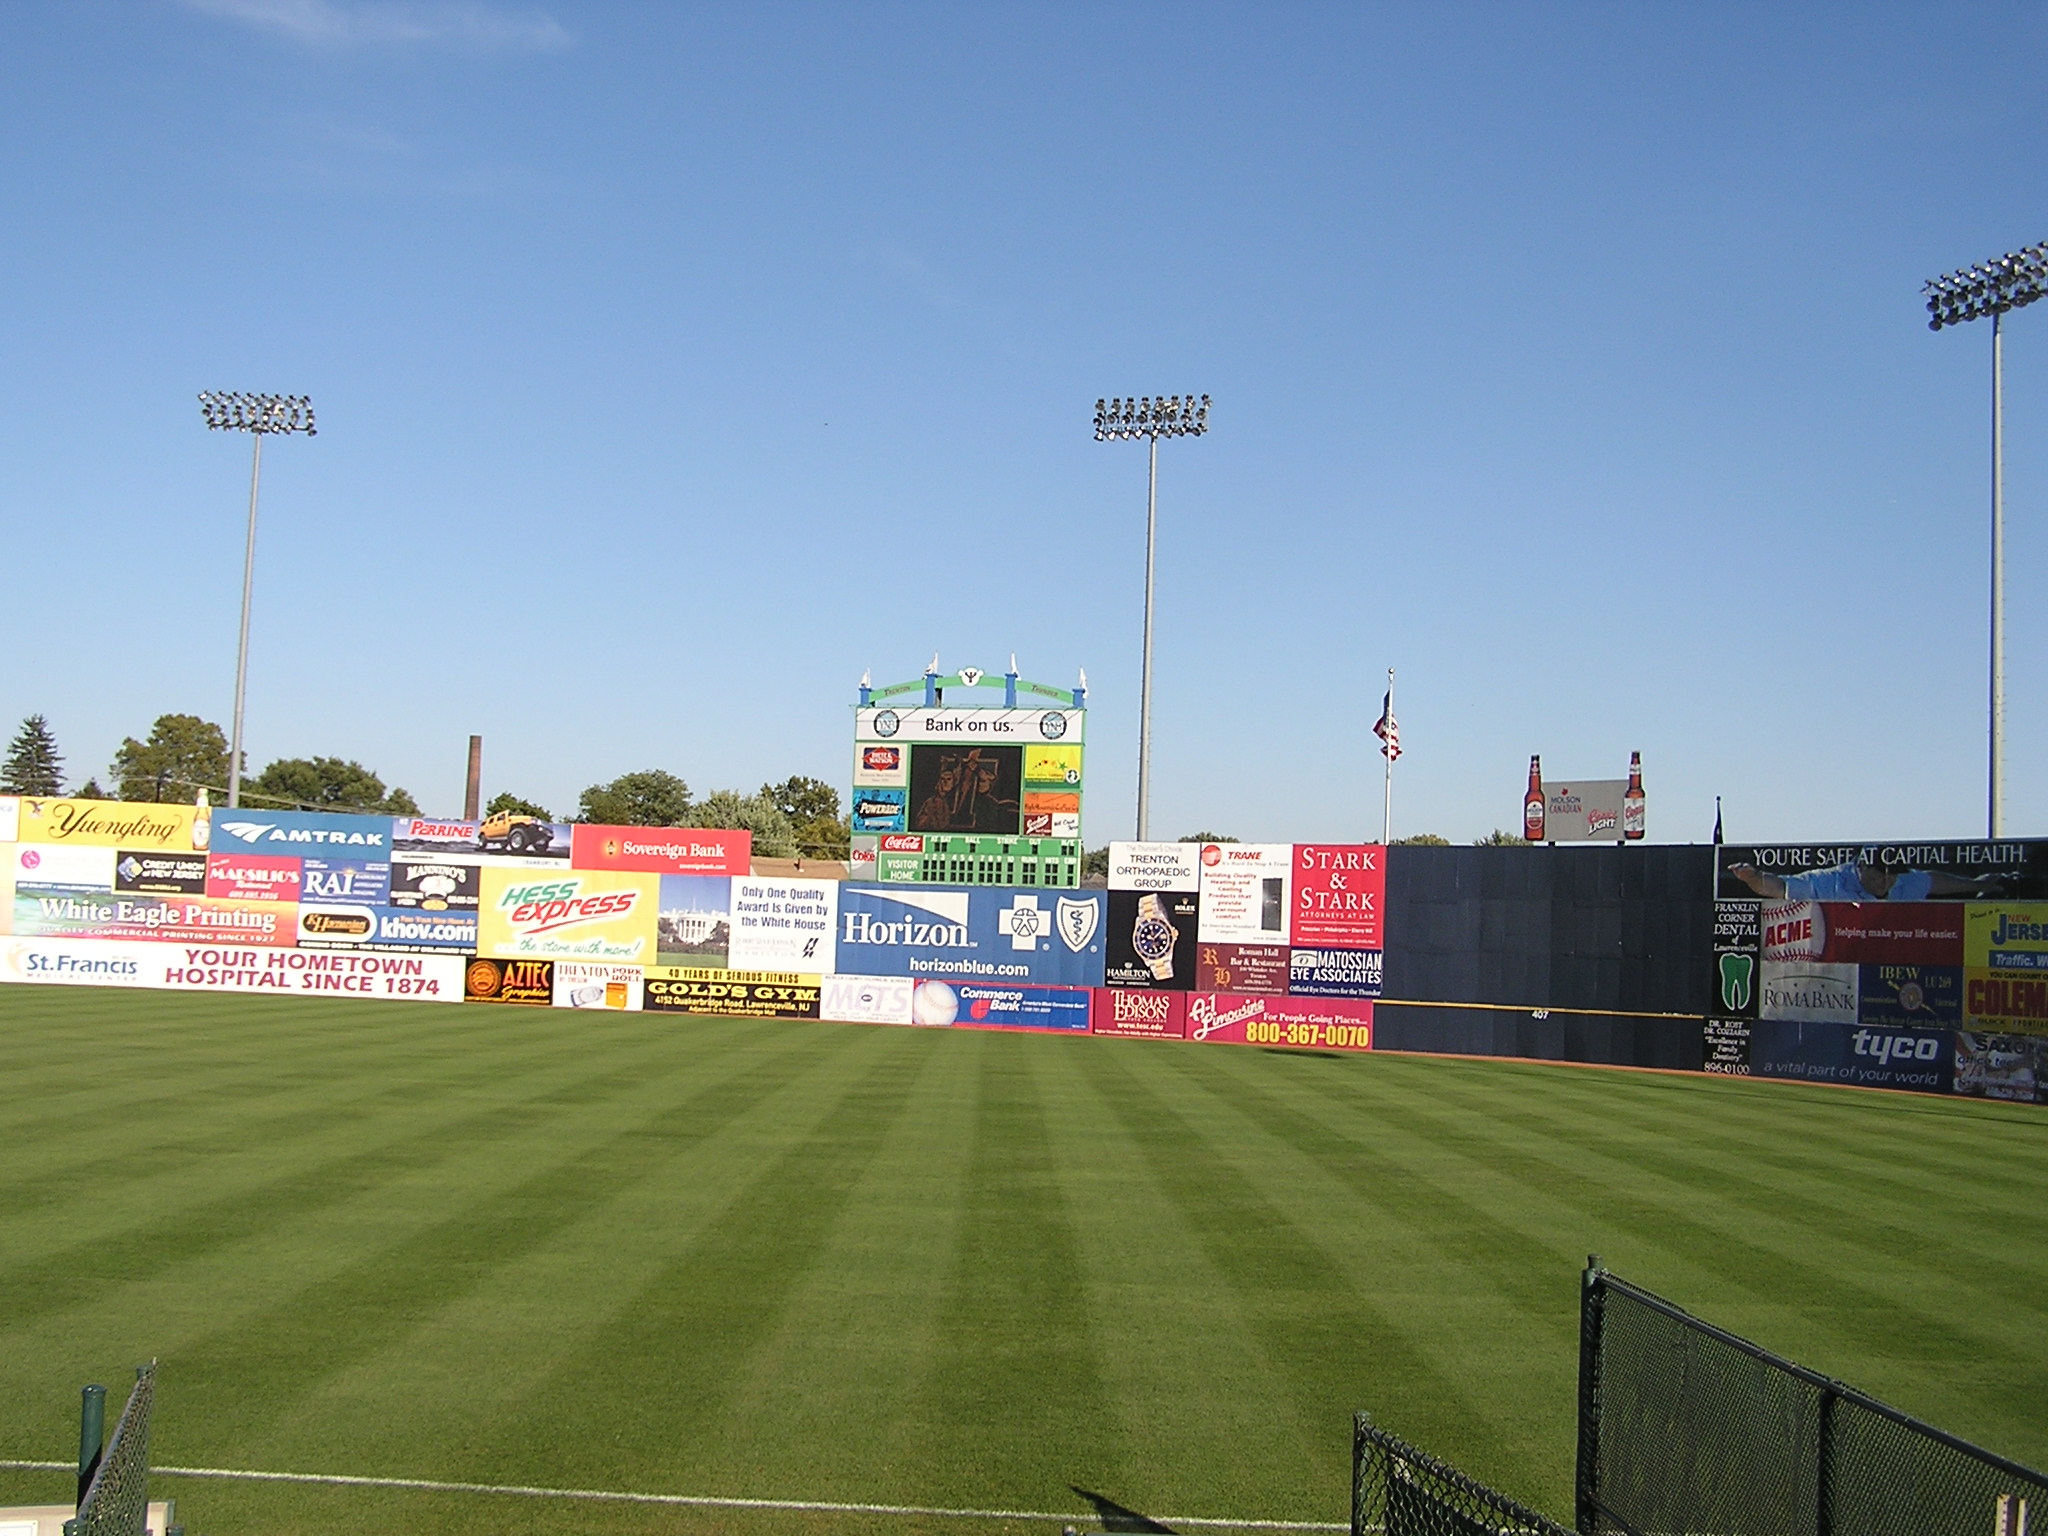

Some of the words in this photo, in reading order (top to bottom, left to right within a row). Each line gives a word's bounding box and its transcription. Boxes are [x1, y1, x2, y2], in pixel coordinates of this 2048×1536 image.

[925, 717, 963, 733] Bank
[967, 721, 988, 733] on
[992, 721, 1014, 733] us.
[48, 803, 184, 846] Yuengling
[409, 819, 475, 840] PERRINE
[1588, 819, 1616, 836] LIGHT
[268, 829, 384, 847] AMTRAK
[884, 836, 921, 850] Coca-Cola
[622, 840, 688, 861] Sovereign
[690, 843, 726, 858] Bank
[1228, 851, 1264, 861] TRANE
[1301, 847, 1377, 870] STARK
[1753, 848, 1811, 869] YOU'RE
[1816, 847, 1854, 869] SAFE
[1857, 846, 1879, 866] AT
[1880, 846, 1950, 866] CAPITAL
[1956, 844, 2029, 867] HEALTH.
[886, 859, 919, 871] VISITOR
[1130, 854, 1179, 865] TRENTON
[209, 867, 300, 884] MARSILIO'S
[890, 870, 915, 881] HOME
[1116, 866, 1192, 878] ORTHOPAEDIC
[303, 871, 354, 897] RAI
[1134, 878, 1172, 889] GROUP
[1329, 872, 1348, 890] &
[501, 881, 580, 907] HESS
[742, 886, 766, 901] Only
[767, 887, 787, 900] One
[789, 887, 825, 902] Quality
[1300, 887, 1375, 911] STARK
[38, 897, 112, 923] White
[117, 900, 181, 929] Eagle
[184, 903, 277, 934] Printing
[737, 901, 770, 915] Award
[772, 902, 782, 914] Is
[784, 903, 814, 916] Given
[815, 904, 829, 917] by
[1174, 903, 1196, 912] ROLEX
[1299, 911, 1345, 920] ATTORNEYS
[1347, 912, 1357, 920] AT
[1359, 913, 1374, 921] LAW
[1714, 902, 1760, 913] FRANKLIN
[741, 916, 759, 928] the
[760, 916, 792, 930] White
[793, 917, 827, 932] House
[1717, 913, 1755, 923] CORNER
[2007, 914, 2032, 923] NEW
[87, 928, 159, 939] COMMERCIAL
[162, 929, 214, 942] PRINTING
[380, 916, 477, 942] khov.com
[842, 911, 971, 948] Horizon
[1713, 923, 1760, 936] DENTAL
[1764, 921, 1813, 951] ACME
[1834, 926, 1867, 940] Helping
[1867, 928, 1892, 938] make
[1893, 928, 1914, 941] your
[1914, 928, 1929, 938] life
[1929, 929, 1959, 940] easier.
[518, 937, 537, 952] the
[540, 940, 571, 954] store
[573, 939, 603, 954] with
[604, 939, 643, 958] more!
[1238, 947, 1263, 957] Roman
[184, 949, 258, 970] YOUR
[267, 952, 423, 976] HOMETOWN
[909, 957, 1030, 978] horizonblue.com
[1230, 957, 1243, 967] Bar
[1317, 951, 1382, 971] MATOSSIAN
[502, 961, 552, 988] AZTEC
[558, 965, 610, 979] TRENTON
[611, 968, 643, 977] PORK
[611, 975, 643, 983] ROLL
[668, 968, 680, 979] 40
[683, 969, 710, 980] YEARS
[713, 970, 723, 981] OF
[726, 971, 762, 983] SERIOUS
[765, 973, 800, 985] FITNESS
[1106, 967, 1151, 980] HAMILTON
[1290, 967, 1310, 982] EYE
[1312, 969, 1382, 985] ASSOCIATES
[1879, 966, 1921, 981] IBEW
[1989, 971, 2003, 979] YOU
[2004, 972, 2018, 980] CAN
[2019, 972, 2042, 981] COUNT
[164, 967, 292, 988] HOSPITAL
[301, 973, 374, 992] SINCE
[384, 977, 441, 996] 1874
[647, 981, 749, 999] GOLD'S
[960, 985, 1024, 1002] Commerce
[1110, 988, 1171, 1010] THOMAS
[1764, 989, 1810, 1010] ROMA
[1812, 991, 1855, 1011] BANK
[799, 1002, 811, 1012] NJ
[990, 999, 1020, 1012] Bank
[1113, 1003, 1168, 1021] EDISON
[1192, 998, 1266, 1041] Limousine
[1263, 1011, 1277, 1023] For
[1278, 1012, 1307, 1026] People
[1308, 1013, 1333, 1027] Going
[1531, 1010, 1550, 1020] 407
[1245, 1021, 1370, 1049] 800-367-0070
[1851, 1029, 1939, 1065] tyco
[1975, 1037, 2034, 1055] SAXON
[1703, 1061, 1751, 1077] 896-0100
[1763, 1062, 1773, 1073] a
[1776, 1061, 1807, 1074] vital
[1807, 1064, 1836, 1078] part
[1839, 1065, 1858, 1079] of
[1858, 1069, 1892, 1083] your
[1894, 1072, 1939, 1086] world
